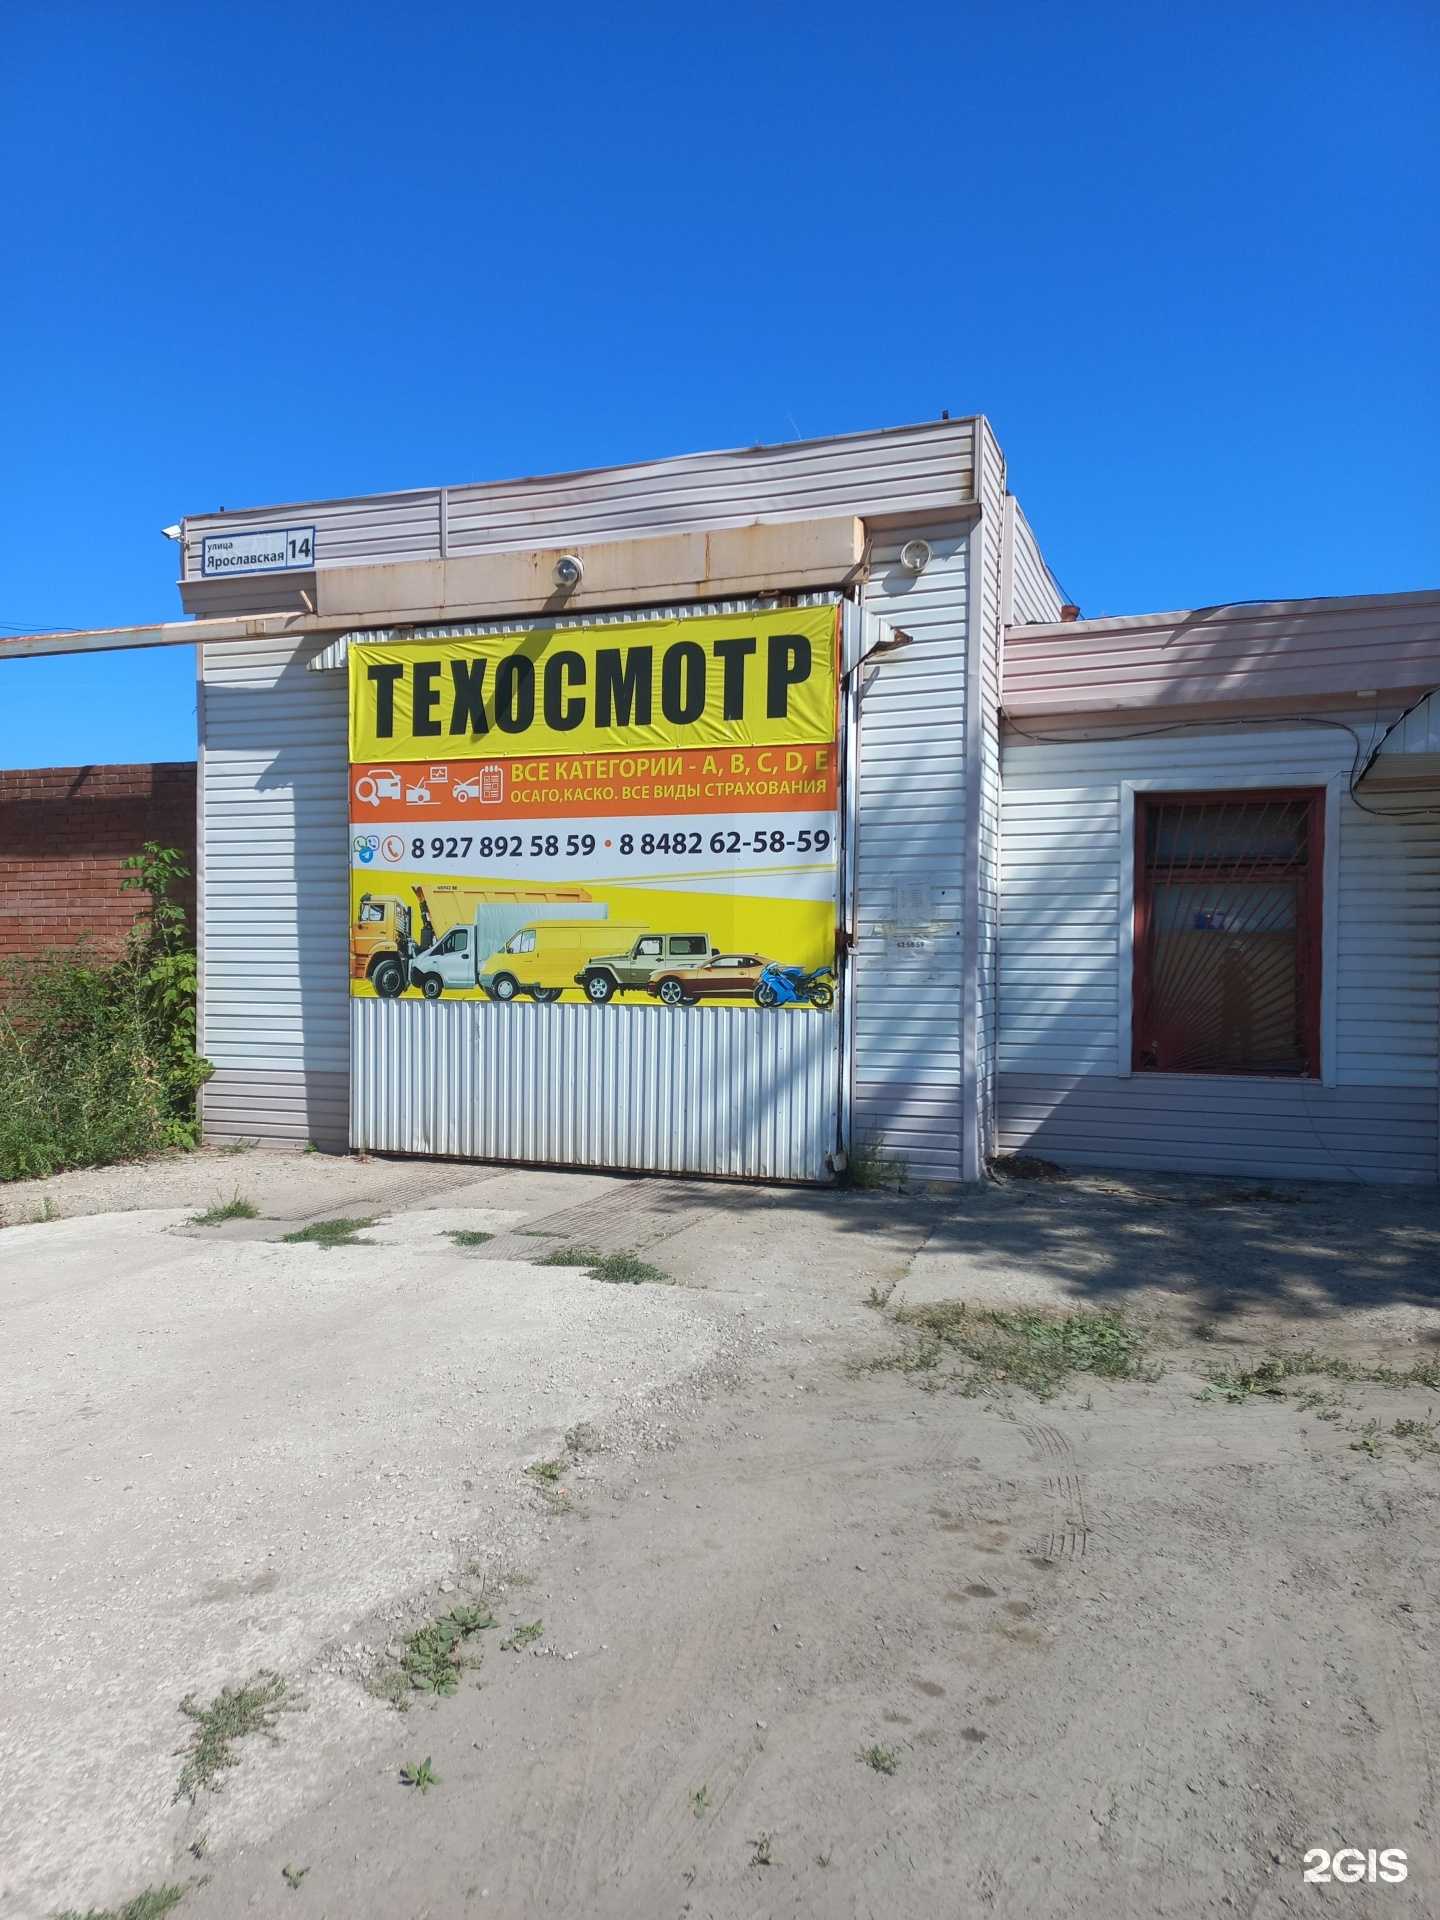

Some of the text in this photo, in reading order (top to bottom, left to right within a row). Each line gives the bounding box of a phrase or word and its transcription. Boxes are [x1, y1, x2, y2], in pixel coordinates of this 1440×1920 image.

[207, 541, 233, 552] улица
[288, 537, 311, 559] 14
[207, 551, 285, 570] Ярославская
[367, 634, 813, 739] ТЕХОСМОТР
[511, 763, 549, 782] ВСЕ
[555, 757, 683, 781] КАТЕГОРИИ
[702, 755, 724, 777] A,
[730, 754, 751, 776] B,
[757, 752, 778, 775] C,
[785, 751, 808, 774] D,
[815, 750, 829, 772] E
[622, 785, 650, 800] ВСЕ
[654, 783, 701, 800] ВИДЫ
[704, 779, 827, 798] СТРАХОВАНИЯ
[411, 833, 596, 859] 8 927 892 58 59
[619, 829, 830, 856] 8 8482 62-58-59
